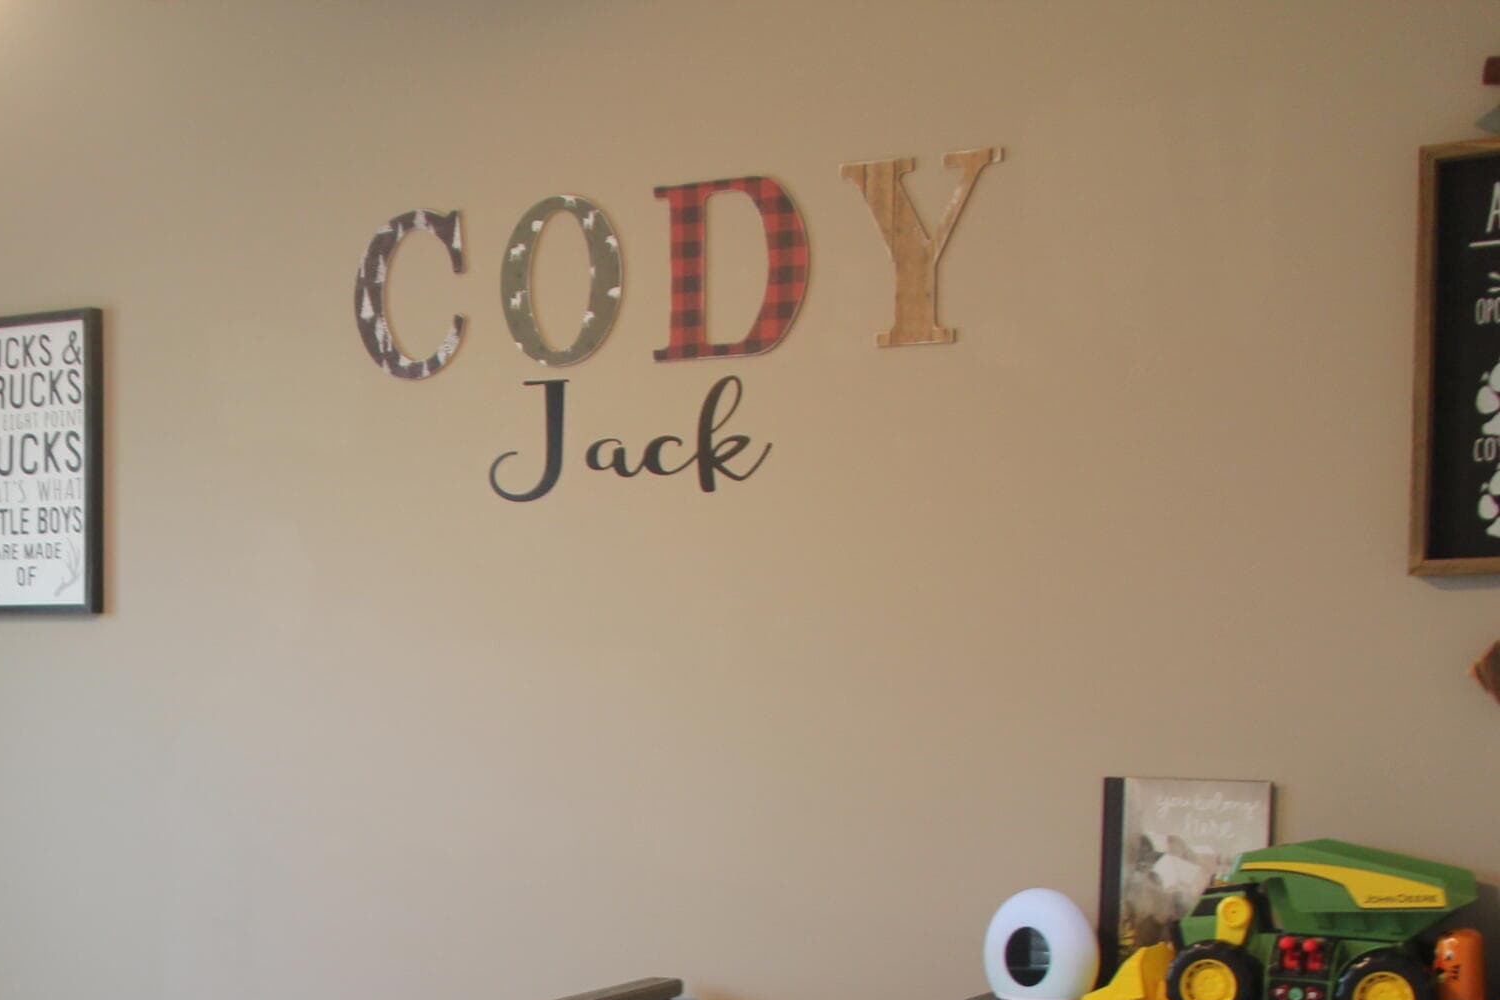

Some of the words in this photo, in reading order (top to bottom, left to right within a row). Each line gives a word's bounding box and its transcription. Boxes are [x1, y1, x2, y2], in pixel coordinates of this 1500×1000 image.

[355, 147, 1004, 380] CODY
[61, 330, 82, 365] &
[490, 375, 772, 502] Jack
[38, 477, 83, 501] WHAT
[38, 506, 83, 534] BOYS
[24, 541, 62, 559] MADE
[16, 566, 37, 586] OF
